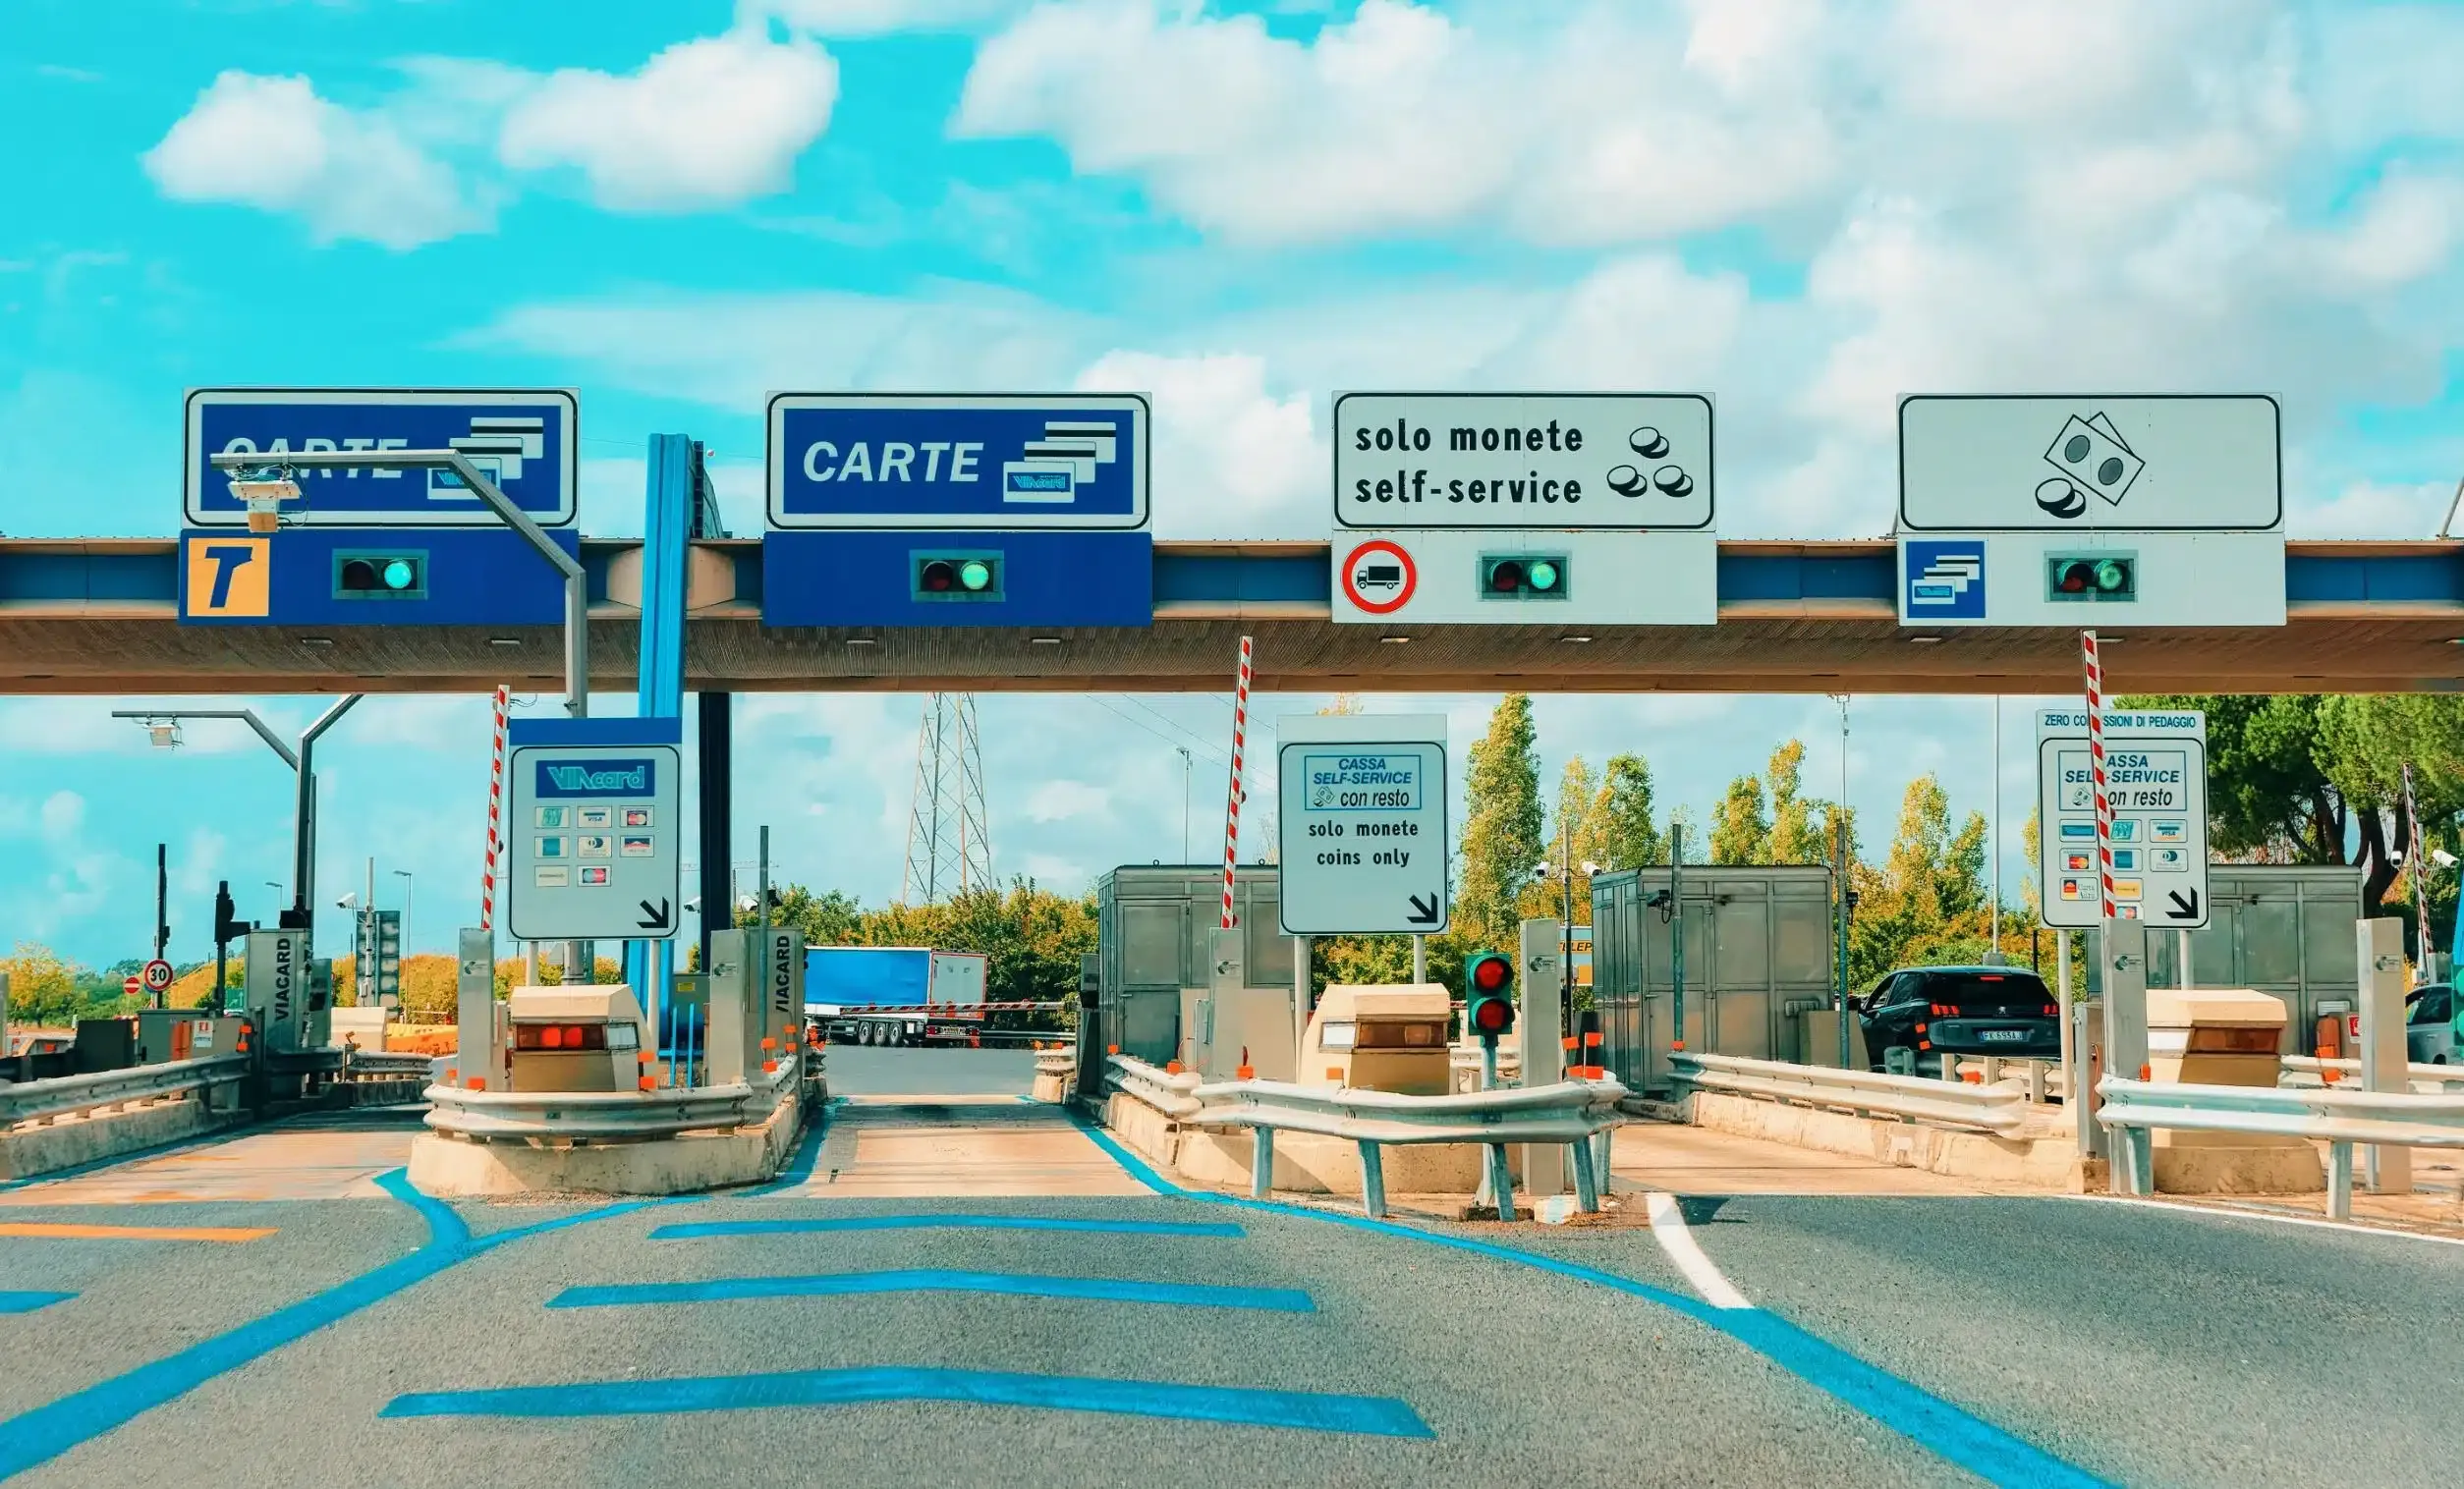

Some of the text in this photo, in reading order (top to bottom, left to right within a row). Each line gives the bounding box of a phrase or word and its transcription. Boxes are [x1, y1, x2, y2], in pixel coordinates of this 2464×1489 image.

[1355, 417, 1584, 452] solo monete
[804, 441, 984, 483] CARTE
[1355, 469, 1583, 503] self-service
[2044, 714, 2197, 728] ZERO COSSIONI DI PEDAGGIO
[1338, 757, 1387, 770] CASSA
[2104, 754, 2149, 768] ASSA
[1313, 771, 1413, 785] SELF-SERVICE
[2064, 770, 2180, 784] SEL-SERVICE
[1339, 788, 1410, 806] con resto
[2105, 788, 2173, 805] on resto
[1308, 819, 1419, 837] solo monete
[1316, 848, 1411, 868] coins only
[149, 968, 166, 982] 30
[274, 937, 292, 1021] VIACARD
